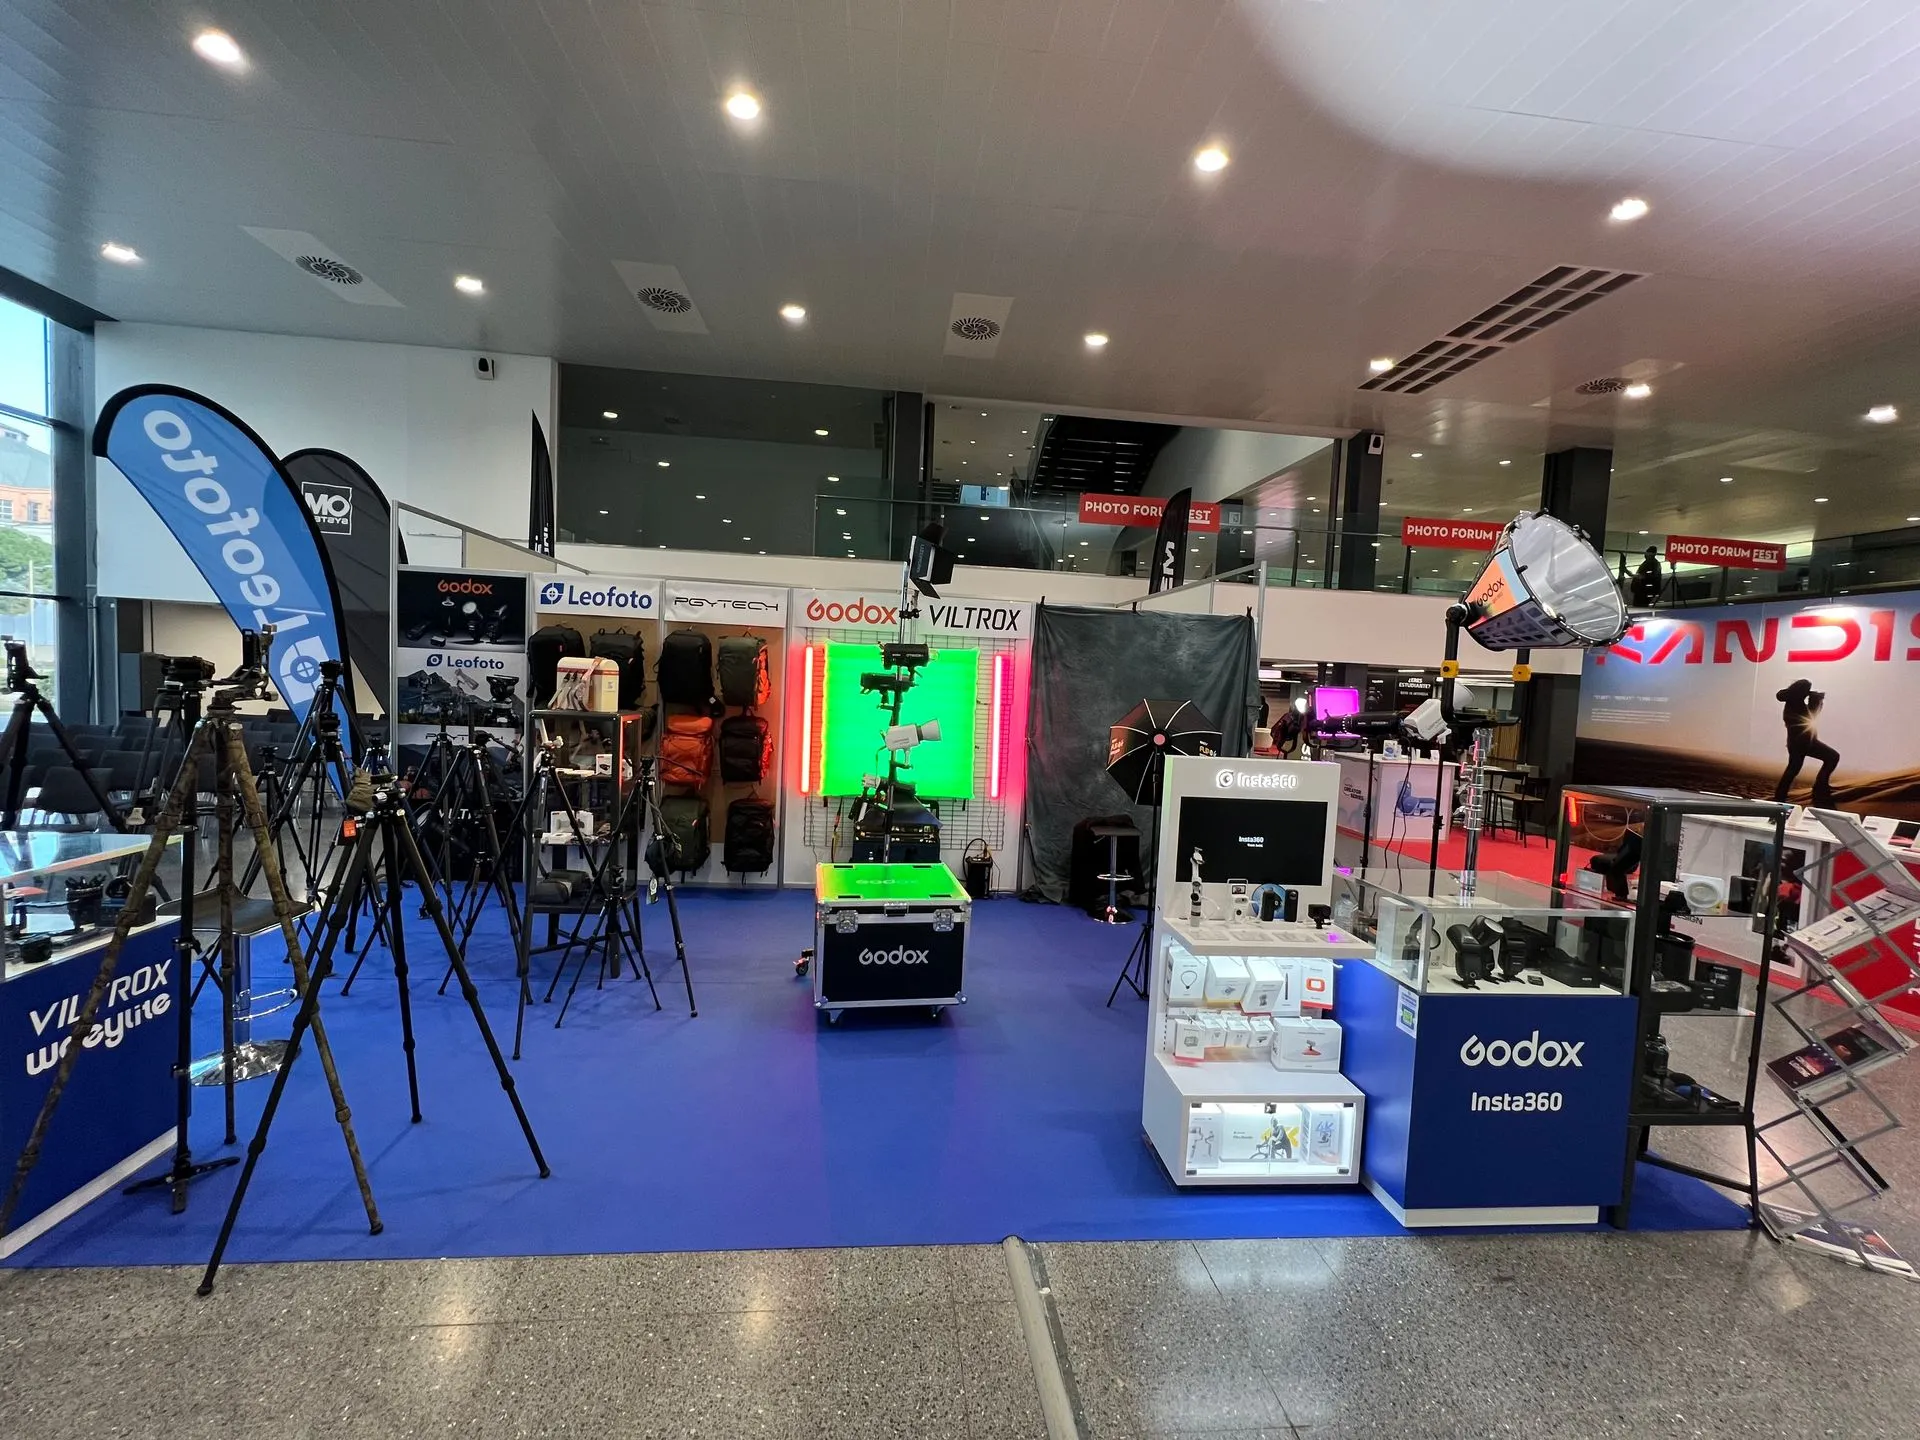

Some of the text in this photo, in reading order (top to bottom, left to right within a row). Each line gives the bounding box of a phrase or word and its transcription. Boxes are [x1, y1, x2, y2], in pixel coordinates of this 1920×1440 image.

[1084, 501, 1212, 521] PHOTO FOR EST
[1407, 524, 1449, 538] PHOTO
[1451, 527, 1493, 541] FORUM
[1670, 542, 1779, 560] PHOTO FORUM FEST
[437, 577, 493, 595] Godox
[568, 584, 653, 609] Leofoto
[673, 596, 779, 612] PGYTECH
[806, 597, 898, 625] Godox
[929, 604, 1022, 632] VILTROX
[447, 655, 505, 670] Leofoto
[1237, 771, 1299, 789] Insta360
[858, 944, 930, 965] Godox
[28, 958, 172, 1037] VILROX
[1460, 1030, 1585, 1068] Godox
[1471, 1092, 1563, 1112] Insta360
